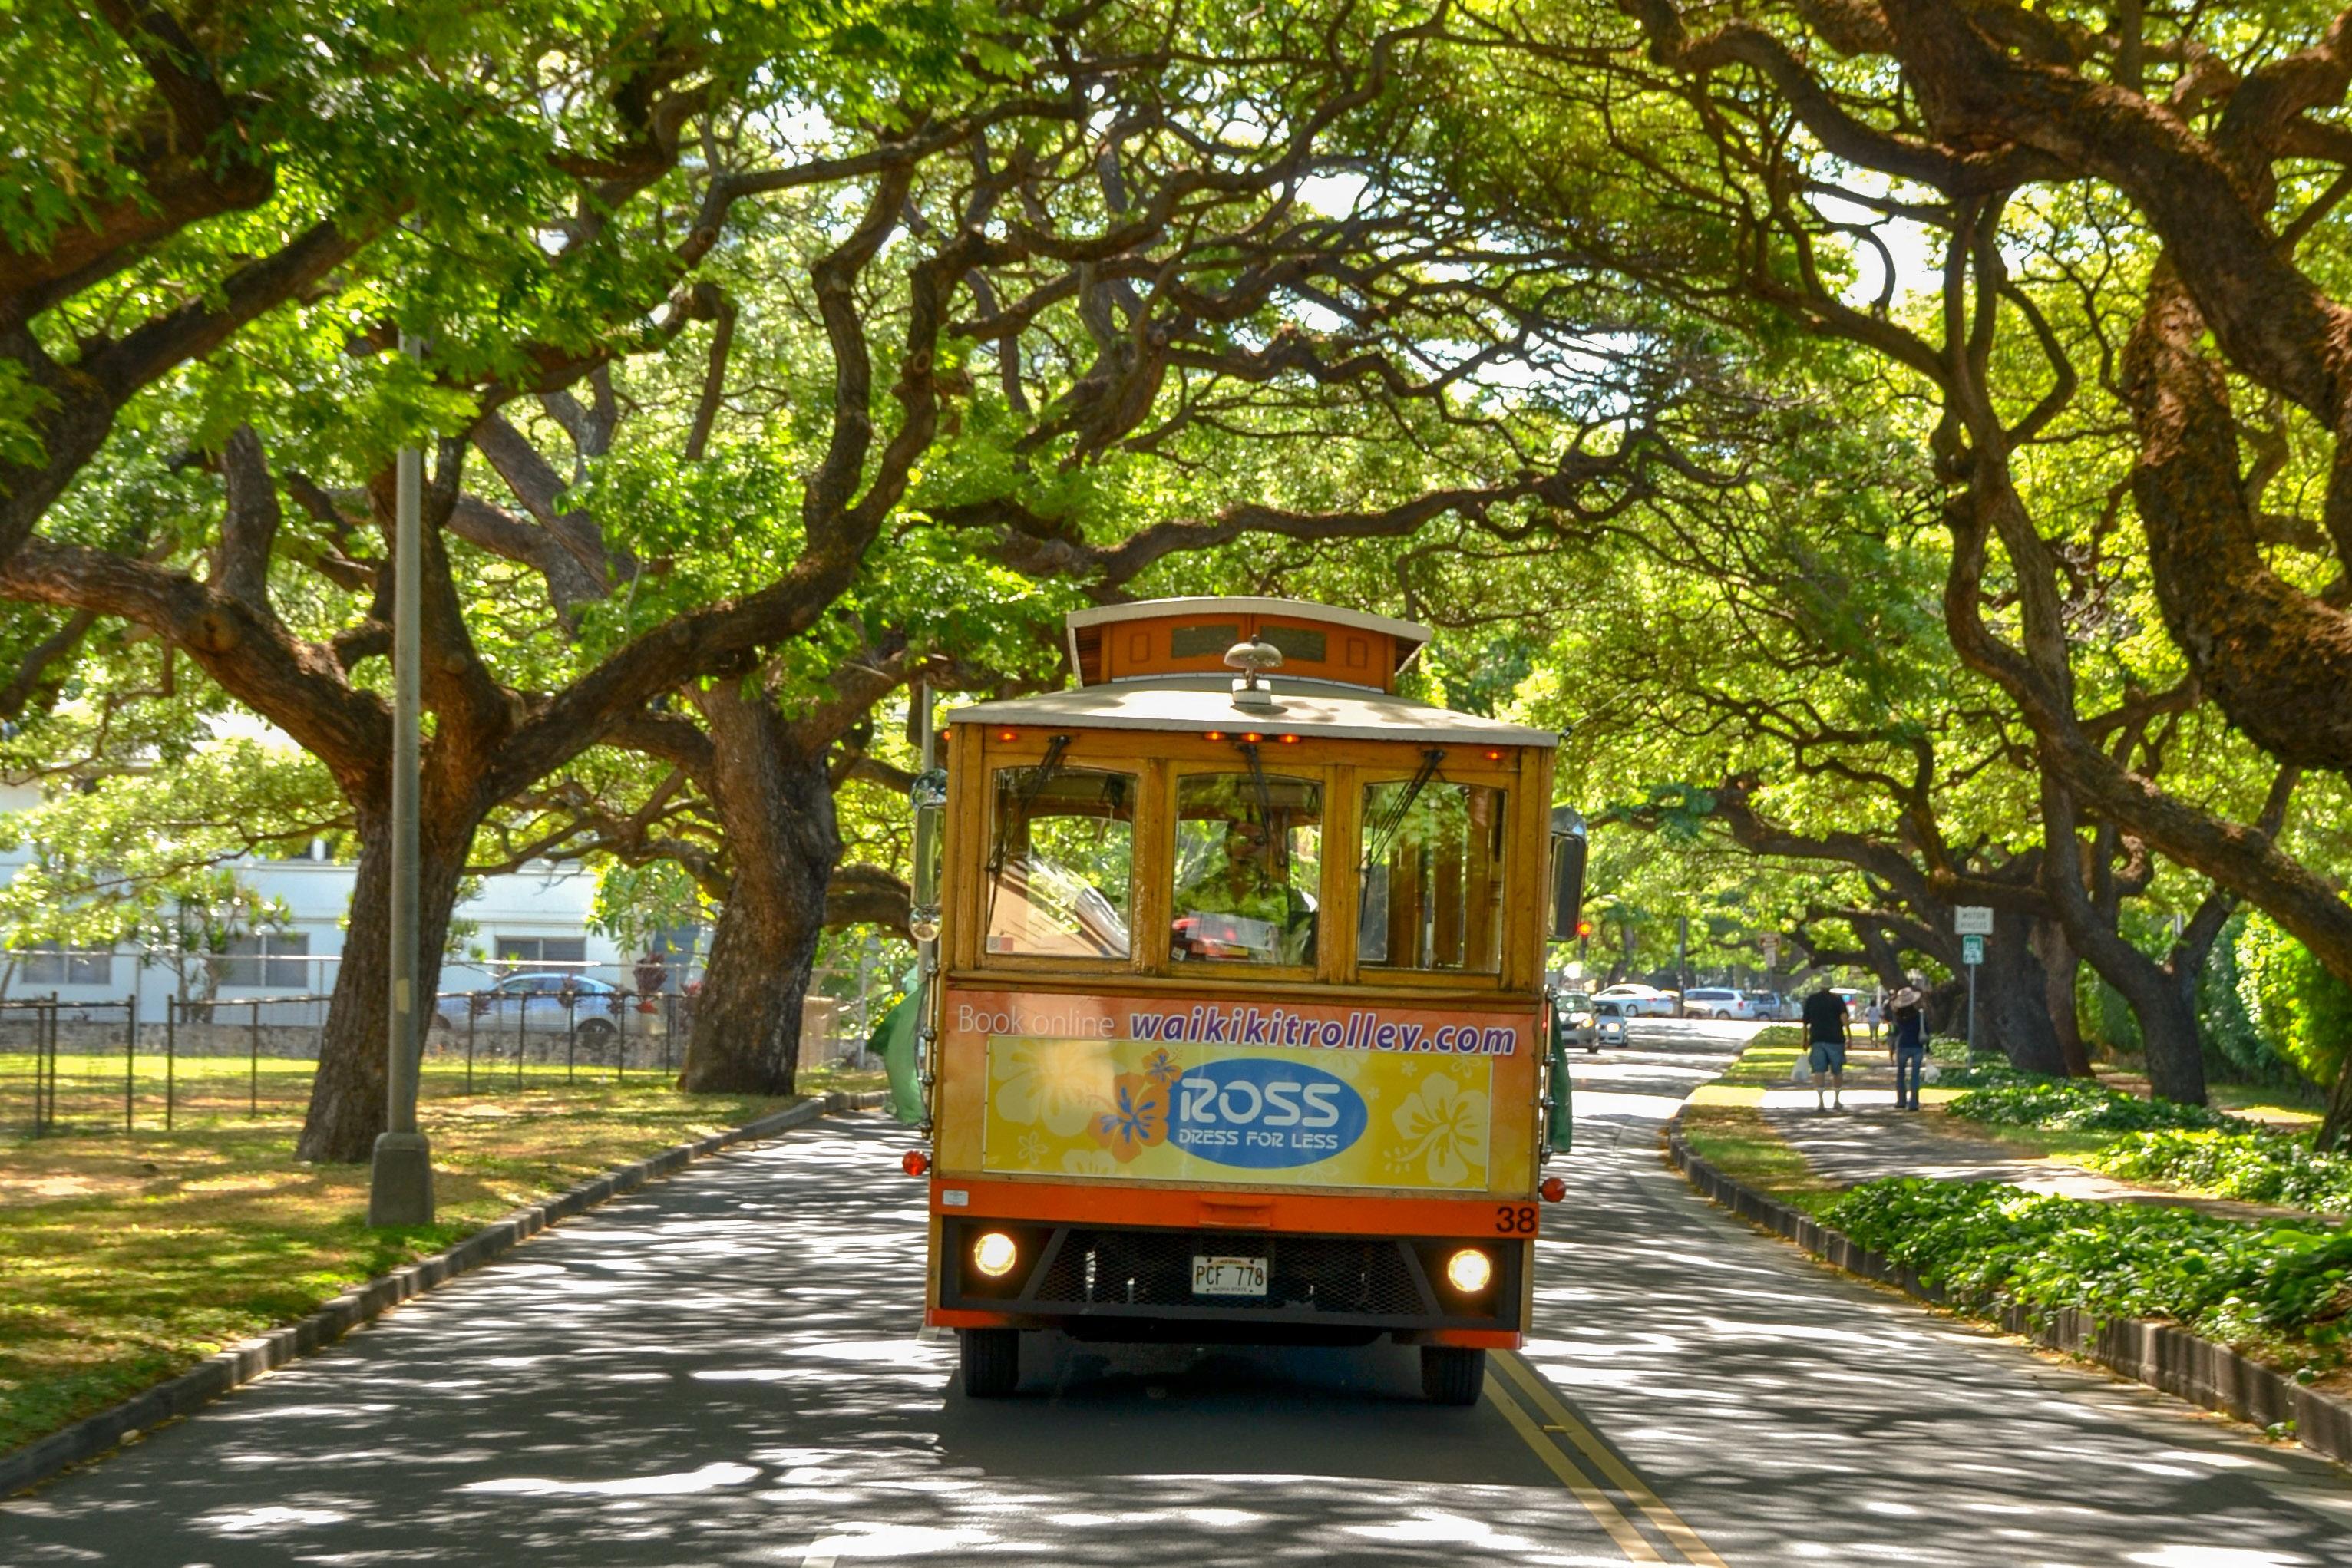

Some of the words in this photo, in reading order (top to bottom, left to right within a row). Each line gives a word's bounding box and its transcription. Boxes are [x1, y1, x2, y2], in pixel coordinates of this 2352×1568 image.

[959, 1005, 1024, 1034] Book
[1033, 1008, 1115, 1038] online
[1130, 1006, 1516, 1055] waikikitrolley.com
[1180, 1078, 1340, 1127] ROSS
[1178, 1128, 1239, 1146] DRESS
[1247, 1131, 1284, 1148] FOR
[1291, 1133, 1339, 1150] LESS
[1495, 1206, 1536, 1233] 38
[1196, 1265, 1225, 1286] PCF
[1235, 1266, 1264, 1286] 778
